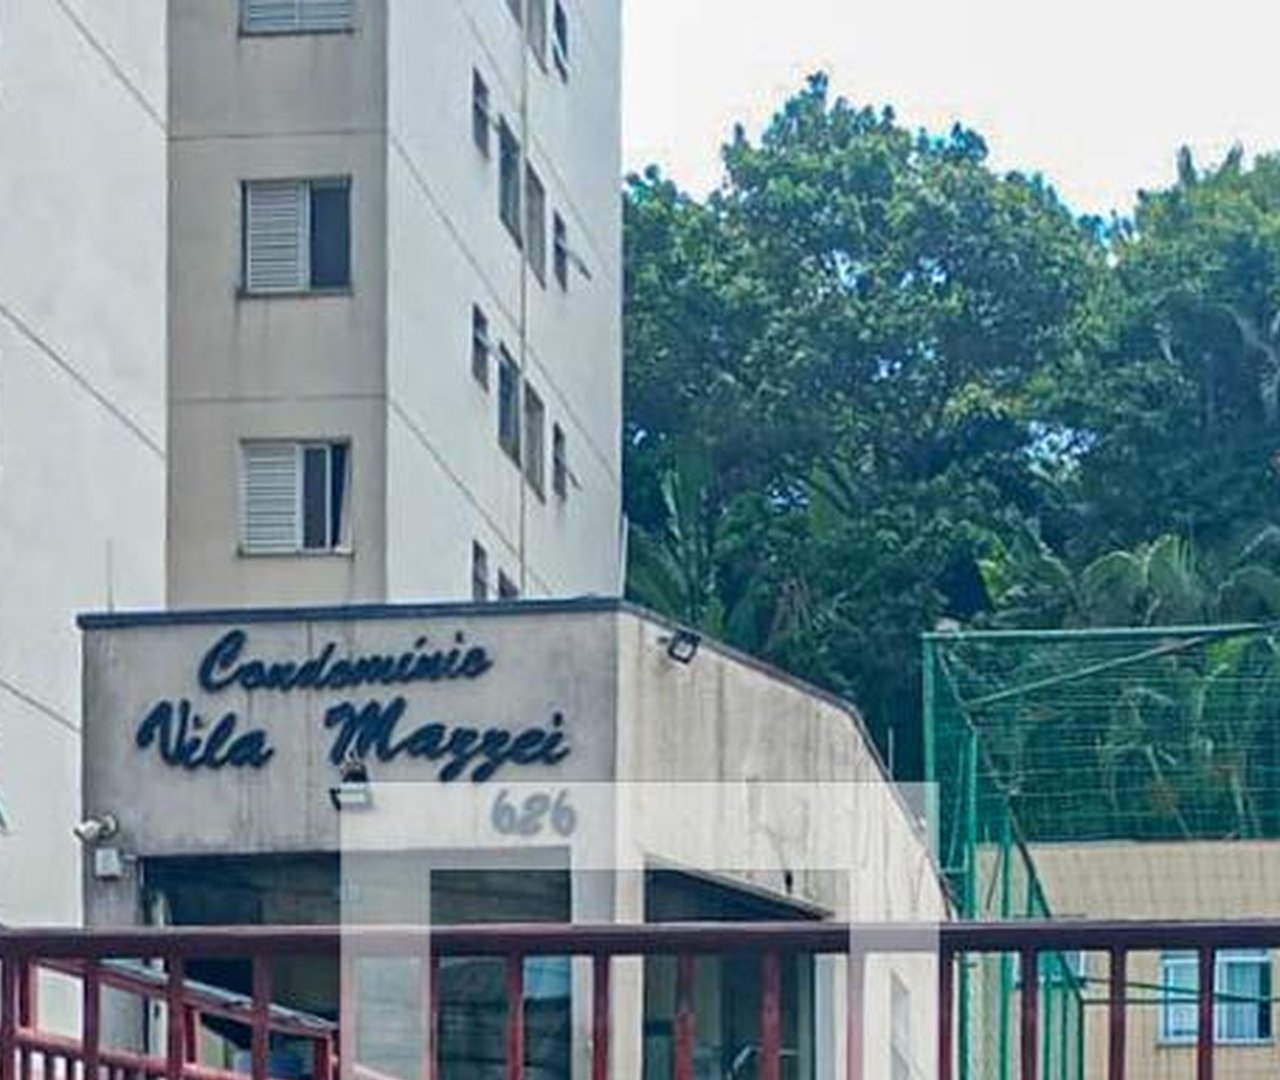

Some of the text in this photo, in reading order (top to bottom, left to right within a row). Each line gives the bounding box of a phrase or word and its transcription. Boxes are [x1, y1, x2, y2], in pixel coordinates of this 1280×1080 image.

[197, 630, 493, 693] Condomínio
[136, 697, 572, 783] Vila Mazzei
[490, 789, 578, 837] 626
